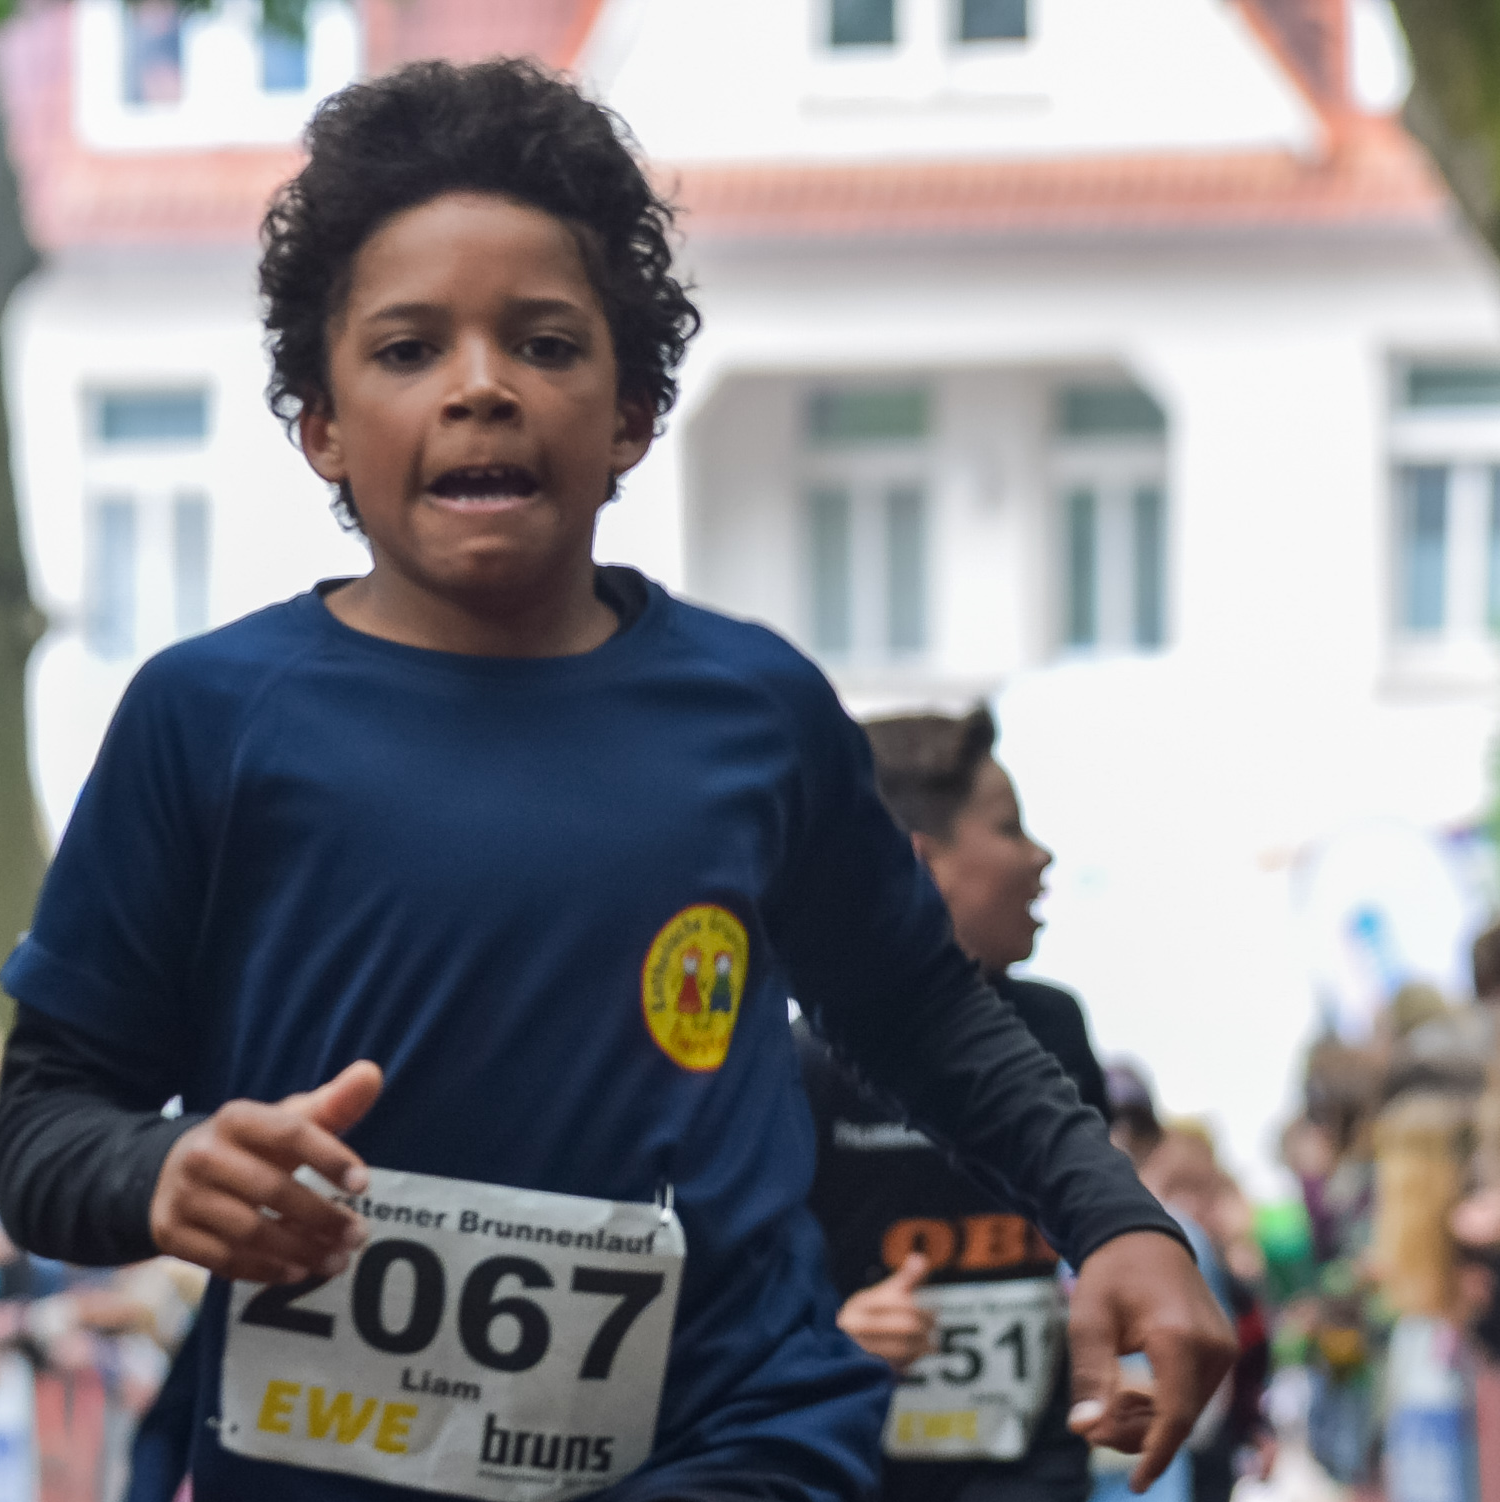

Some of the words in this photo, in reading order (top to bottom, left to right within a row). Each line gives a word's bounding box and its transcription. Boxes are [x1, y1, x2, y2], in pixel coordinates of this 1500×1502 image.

[458, 1208, 658, 1256] Brunnenlauf
[240, 1238, 665, 1381] 2067
[401, 1367, 482, 1400] Liam
[901, 1319, 1028, 1386] 51
[257, 1379, 419, 1455] EWE
[479, 1411, 615, 1473] bruns
